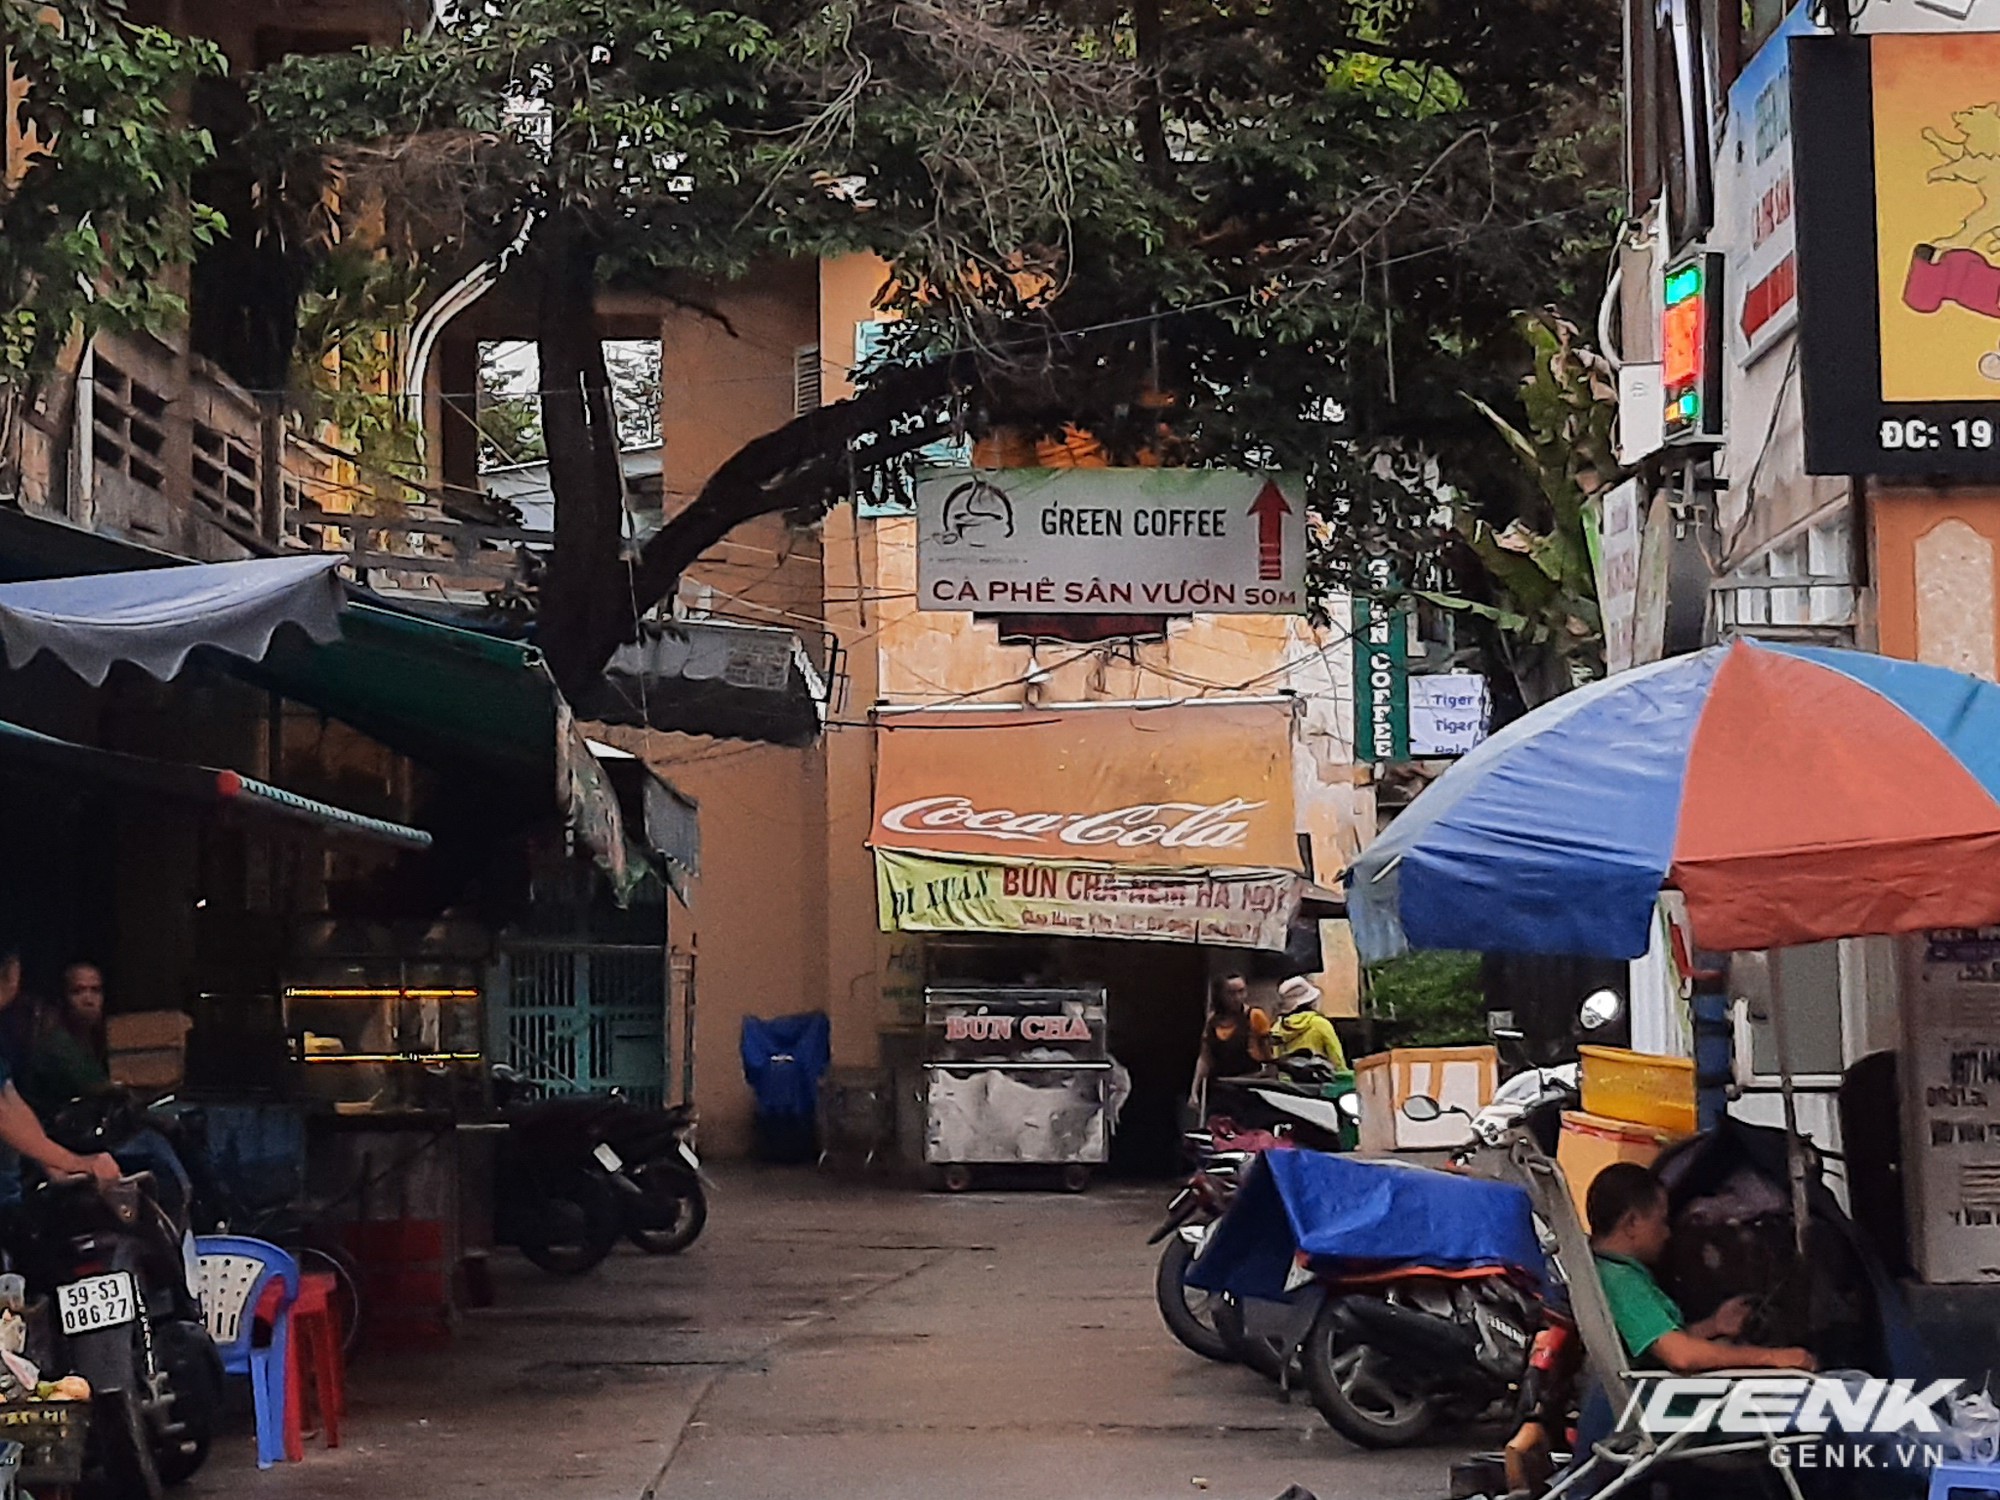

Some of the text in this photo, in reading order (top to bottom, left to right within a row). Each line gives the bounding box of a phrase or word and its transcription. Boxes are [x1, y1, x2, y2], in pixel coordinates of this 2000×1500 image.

[1880, 419, 1992, 449] ĐC: 19
[1041, 500, 1227, 537] GREEN COFFEE
[988, 577, 1055, 603] PHÊ
[1064, 578, 1132, 604] SÂN
[1431, 693, 1474, 709] Tiger
[1435, 718, 1478, 734] Tiger
[1003, 862, 1057, 899] BÚN
[946, 1006, 1014, 1040] BÚN
[66, 1279, 120, 1308] 59-S3
